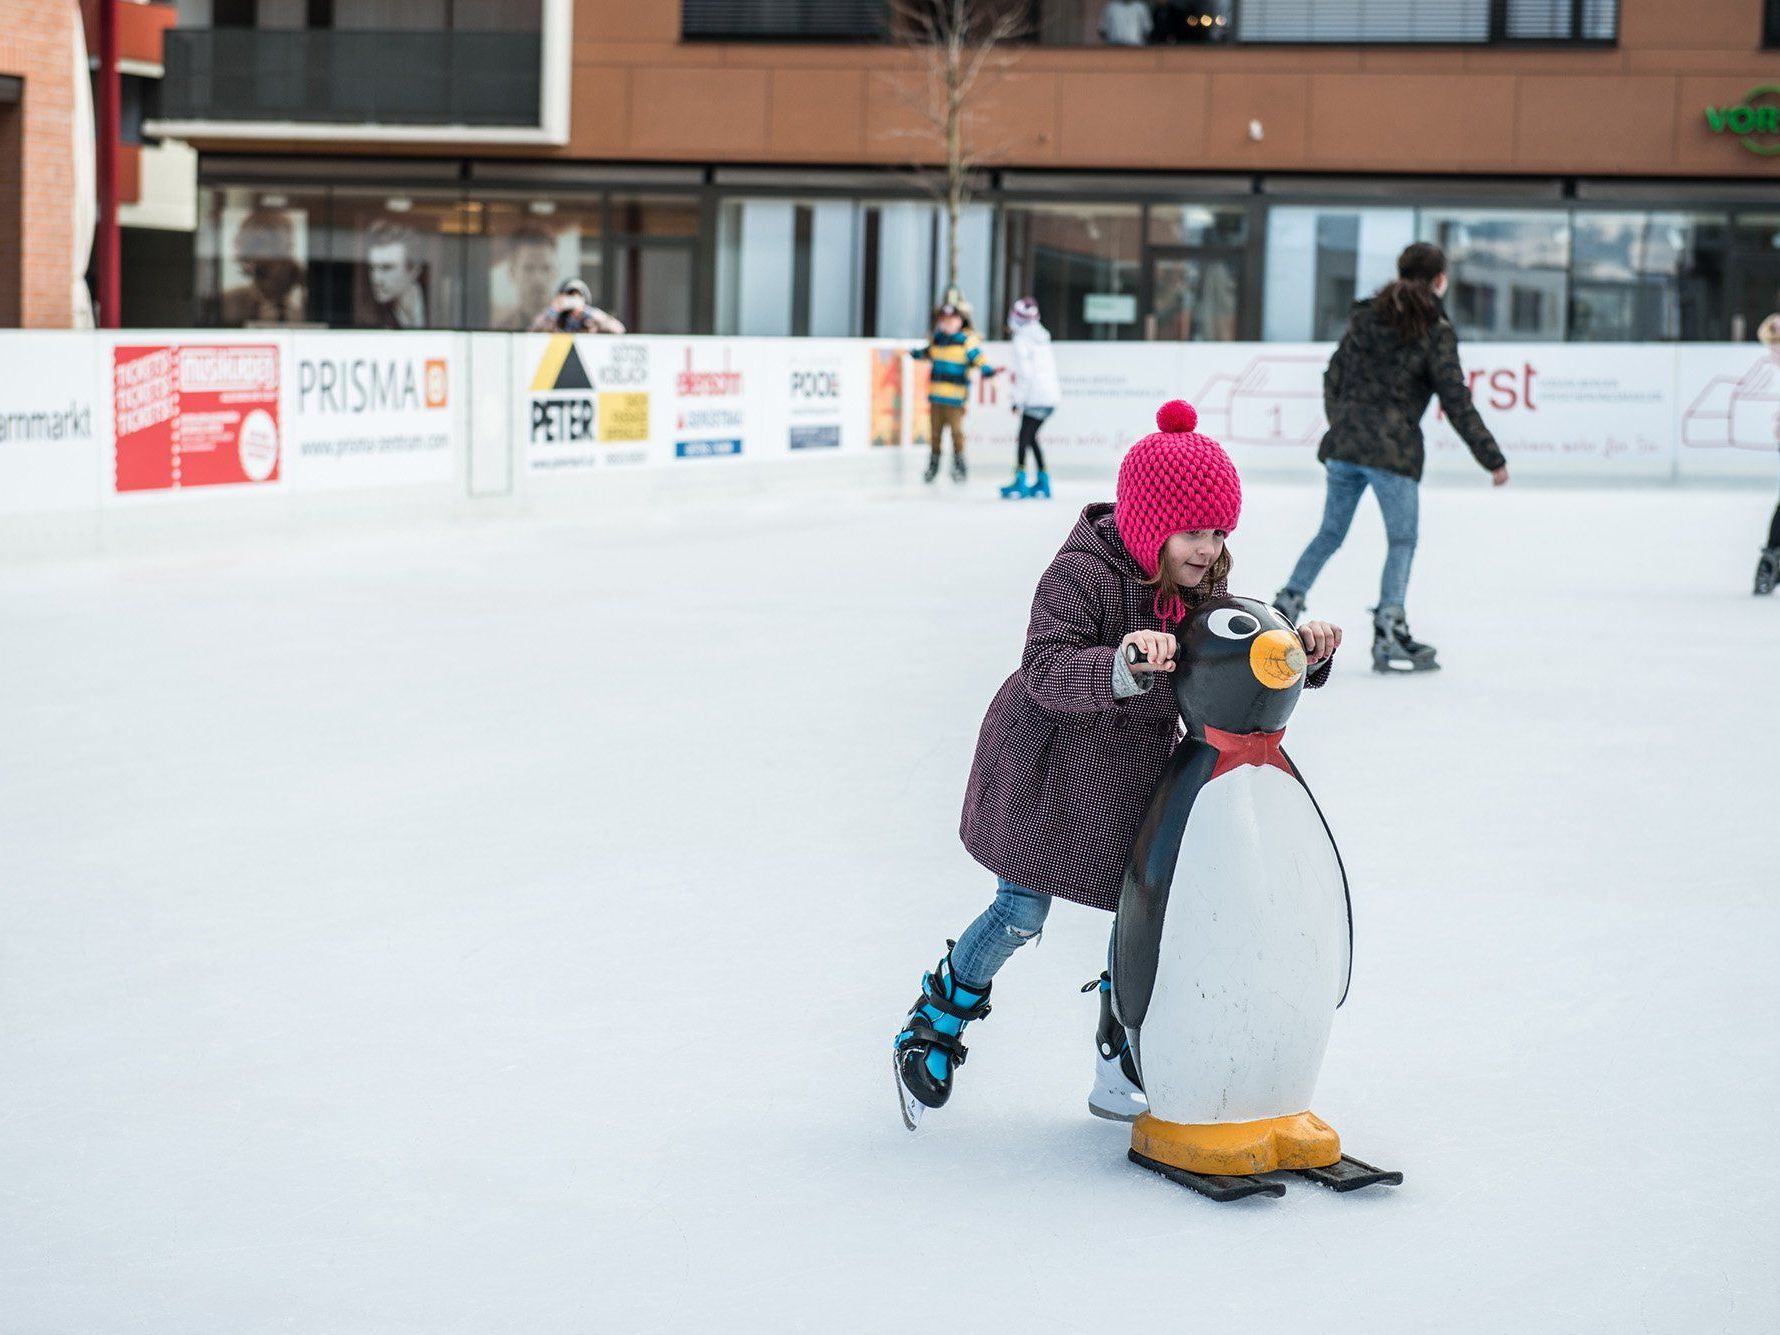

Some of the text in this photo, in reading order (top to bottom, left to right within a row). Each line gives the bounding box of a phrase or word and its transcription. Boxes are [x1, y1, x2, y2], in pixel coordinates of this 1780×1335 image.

[1704, 104, 1780, 133] VOR
[298, 358, 421, 414] PRISMA
[1464, 361, 1538, 412] rst
[531, 398, 595, 443] PETER
